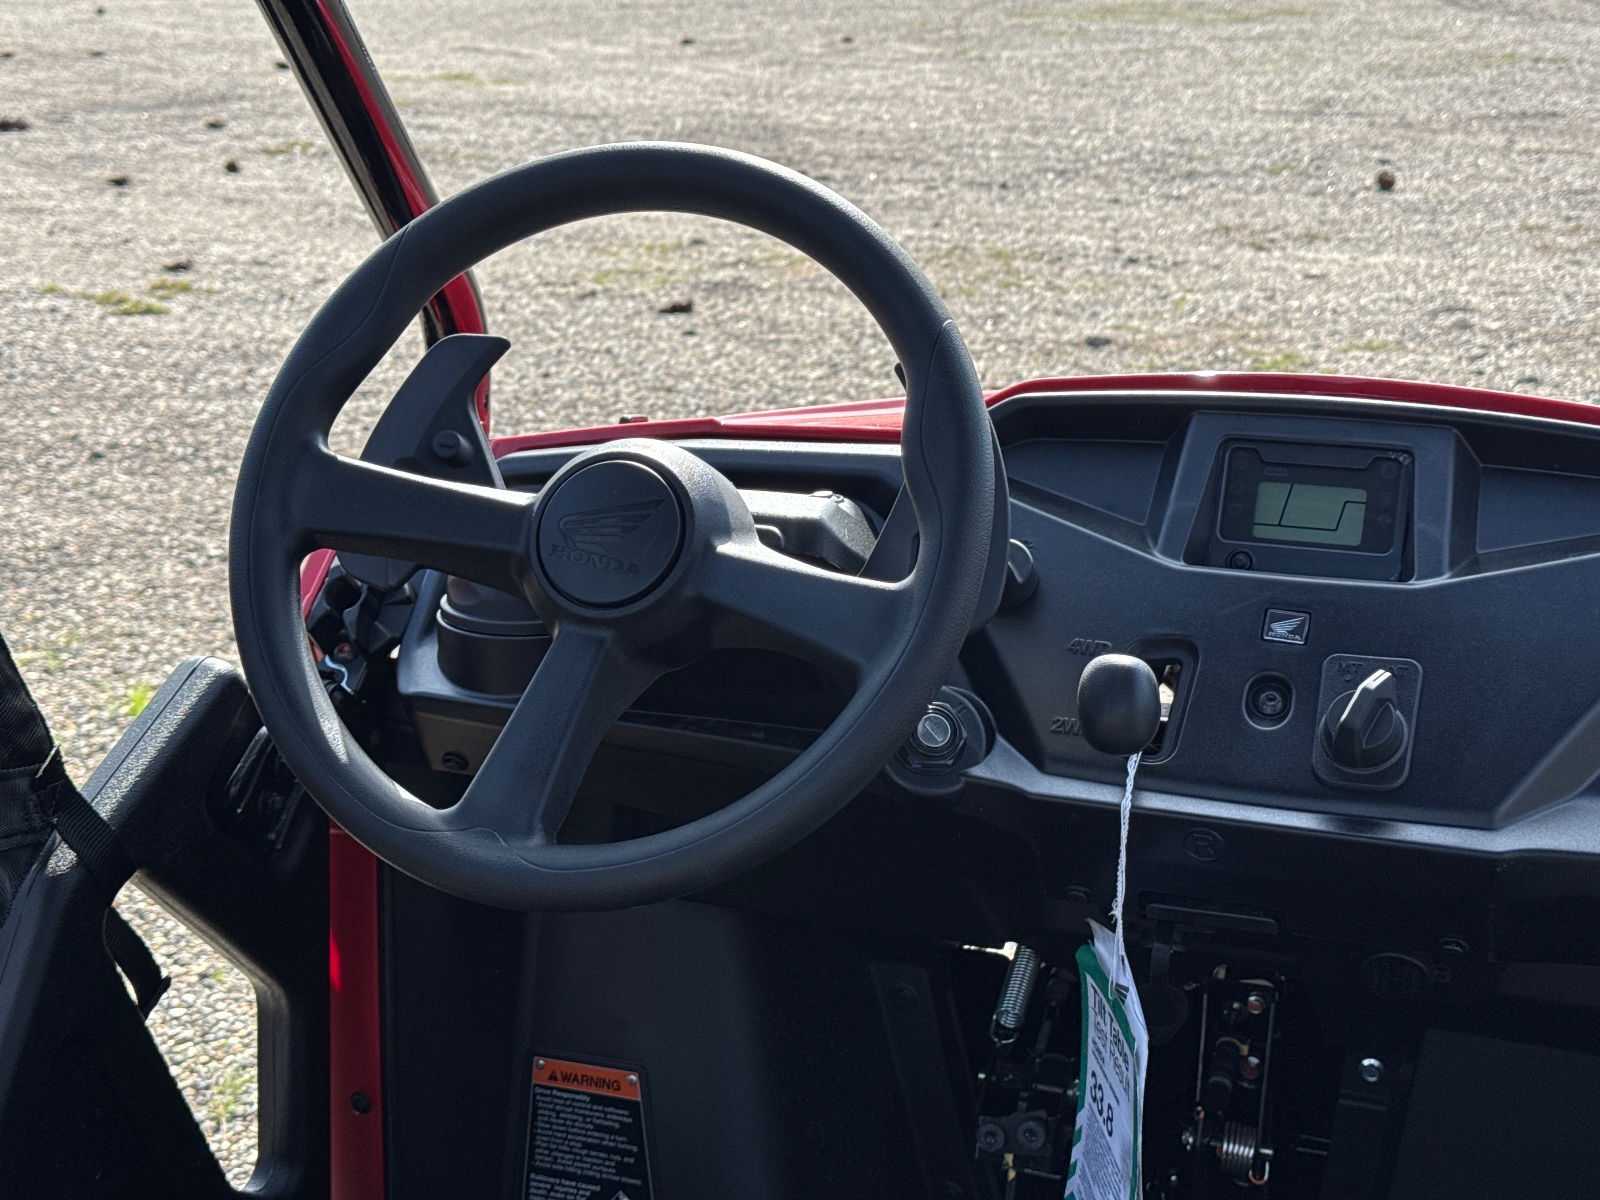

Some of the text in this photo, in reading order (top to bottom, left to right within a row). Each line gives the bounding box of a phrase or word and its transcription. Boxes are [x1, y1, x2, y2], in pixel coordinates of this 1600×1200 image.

[548, 543, 645, 578] HONDA
[1267, 630, 1302, 641] HONDA
[1067, 637, 1112, 655] 4WD
[1336, 660, 1364, 673] MT
[1386, 664, 1409, 677] AT
[1050, 716, 1083, 736] 2W
[1091, 983, 1106, 1025] Tilt
[1107, 1011, 1129, 1072] Table
[1092, 1007, 1108, 1053] Test
[1109, 1039, 1131, 1102] Result
[560, 1071, 621, 1092] WARNING
[1089, 1069, 1114, 1138] 33.8
